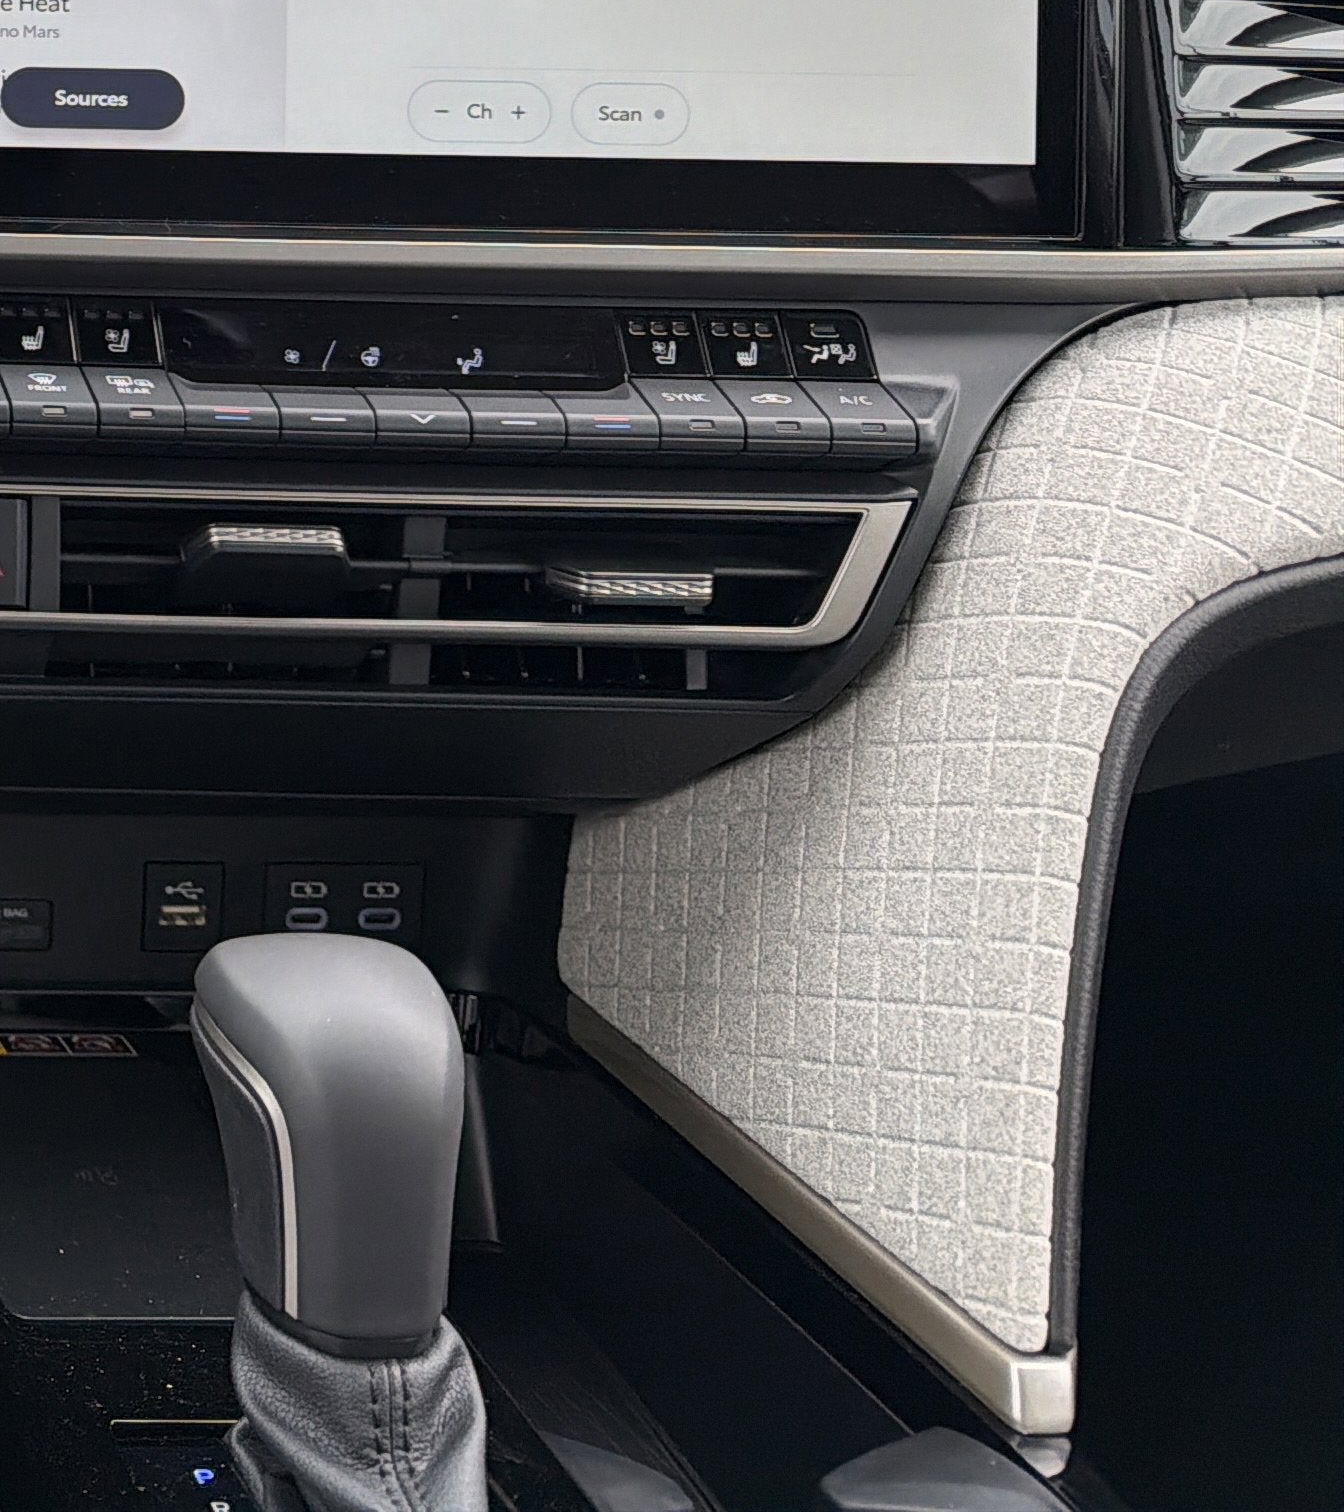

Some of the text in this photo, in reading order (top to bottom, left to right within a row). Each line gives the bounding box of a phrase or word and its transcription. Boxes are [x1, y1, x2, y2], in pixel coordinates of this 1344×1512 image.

[22, 24, 60, 39] Mars
[54, 90, 128, 107] Sources
[467, 103, 492, 119] Ch
[598, 106, 642, 121] Scan
[27, 384, 67, 392] FRONT
[117, 387, 151, 395] REAR
[662, 392, 711, 403] SYNC
[840, 395, 873, 406] A/C
[3, 908, 28, 917] BAG
[193, 1468, 214, 1484] P
